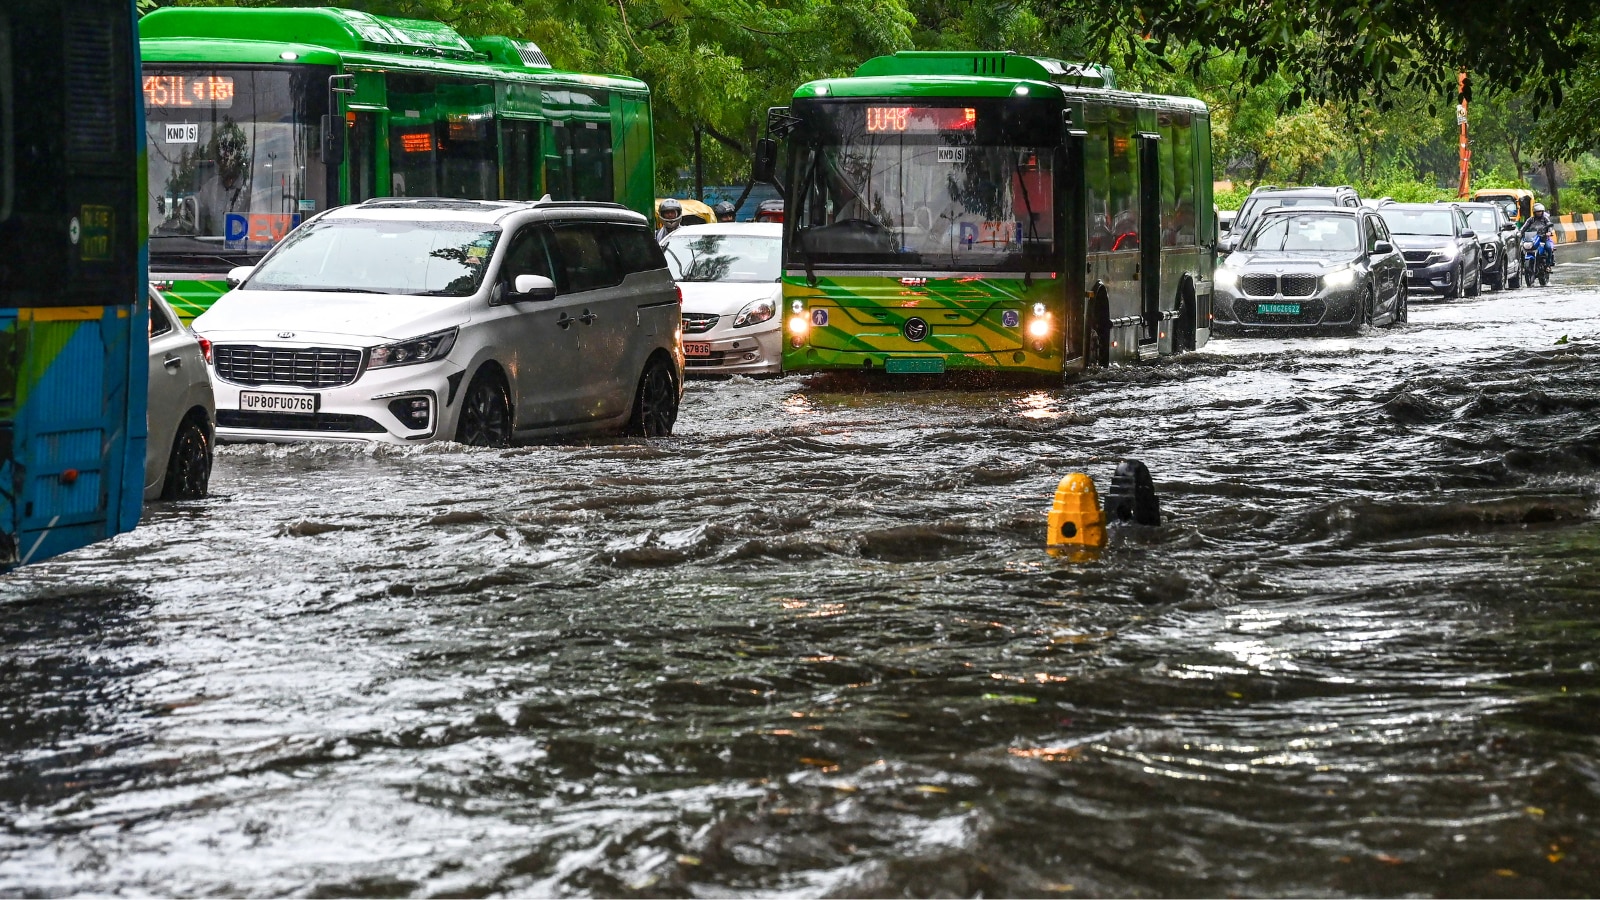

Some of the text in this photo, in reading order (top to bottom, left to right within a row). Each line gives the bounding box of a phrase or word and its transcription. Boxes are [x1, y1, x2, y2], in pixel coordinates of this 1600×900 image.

[167, 126, 197, 141] KND (S)
[939, 148, 965, 161] KND (S)
[247, 396, 313, 410] UP80FU0766
